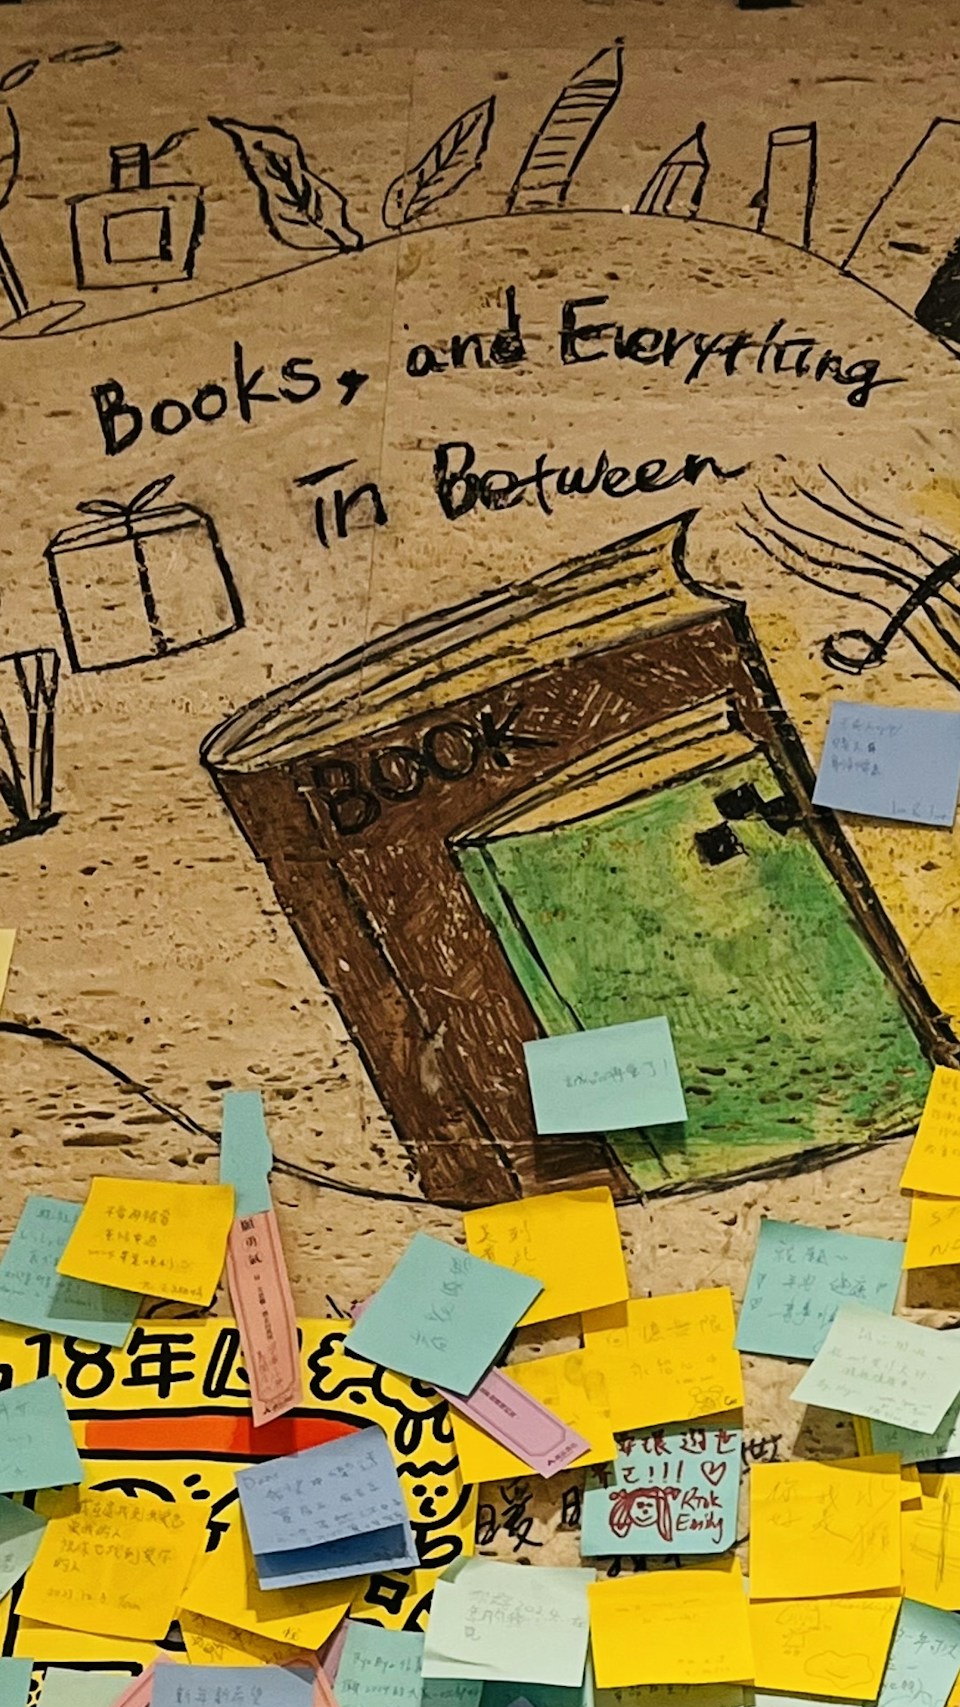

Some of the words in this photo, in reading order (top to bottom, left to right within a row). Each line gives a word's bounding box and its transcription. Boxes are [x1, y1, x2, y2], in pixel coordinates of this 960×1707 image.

[92, 340, 369, 456] Books,
[405, 285, 523, 378] and
[295, 459, 388, 548] in
[434, 442, 752, 520] Between
[304, 700, 559, 839] BOOK
